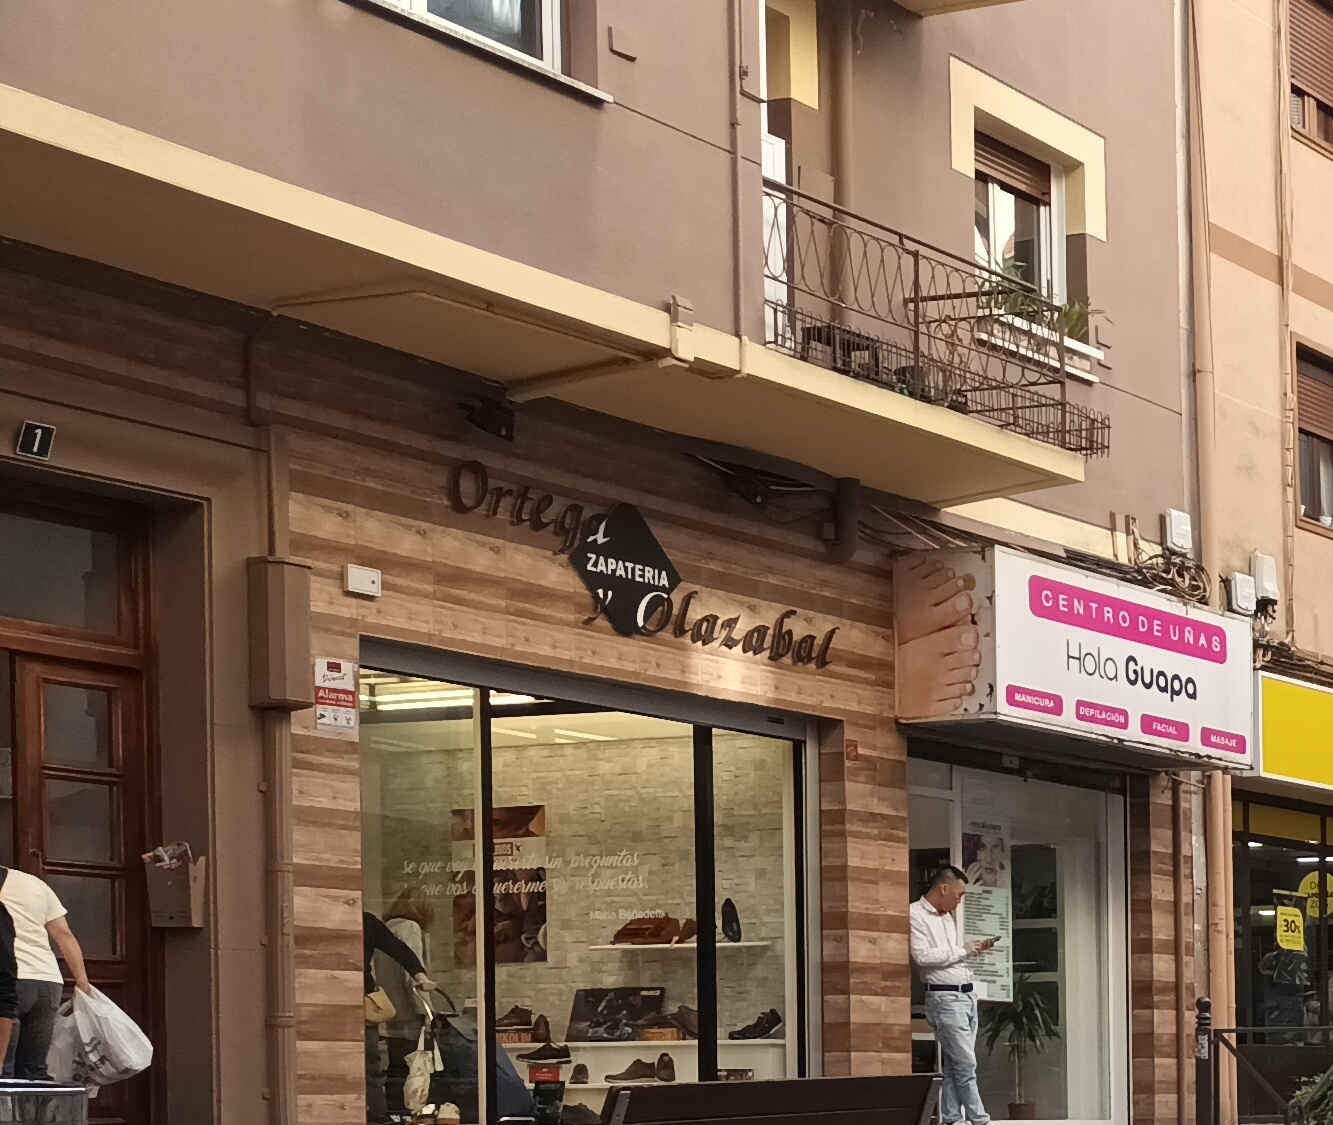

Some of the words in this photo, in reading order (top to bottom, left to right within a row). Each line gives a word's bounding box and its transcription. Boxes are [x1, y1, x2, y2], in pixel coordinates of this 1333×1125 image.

[33, 428, 42, 453] 1
[448, 458, 611, 557] Ortega
[586, 552, 670, 588] ZAPATERIA
[636, 589, 841, 671] Olazabal
[1040, 589, 1131, 628] CENTRO
[1138, 614, 1163, 637] DE
[1169, 623, 1222, 653] UÑAS
[1065, 639, 1119, 683] Hola
[1124, 654, 1198, 702] Guapa
[317, 688, 353, 702] Alarma
[1014, 691, 1055, 709] MANICURA
[1079, 705, 1125, 725] DEPILACIÓN
[1152, 721, 1178, 736] FACIAL
[1210, 733, 1237, 749] MASAJE
[566, 848, 641, 877] preguntas
